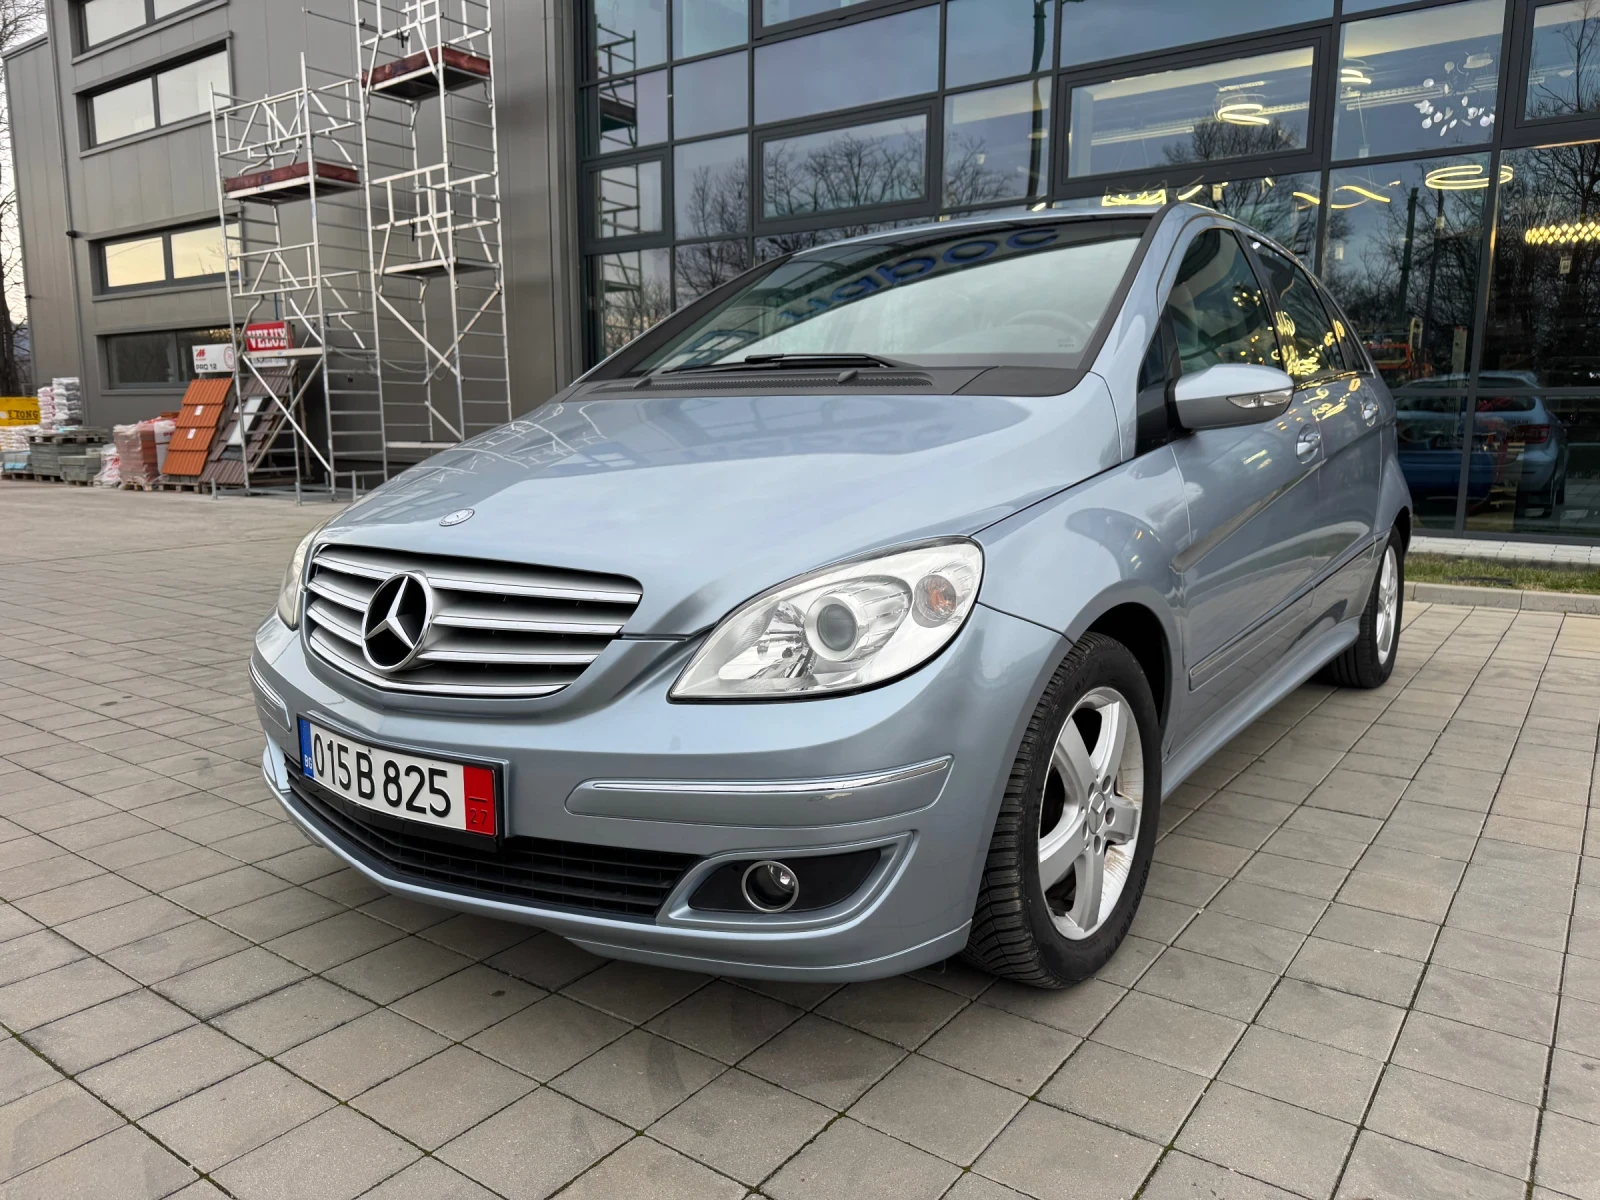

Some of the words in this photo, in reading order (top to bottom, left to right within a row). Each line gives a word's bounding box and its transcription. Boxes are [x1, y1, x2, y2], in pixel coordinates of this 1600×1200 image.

[247, 328, 287, 348] VELUX
[304, 754, 314, 770] BG
[384, 760, 452, 818] 825
[470, 808, 488, 826] 27
